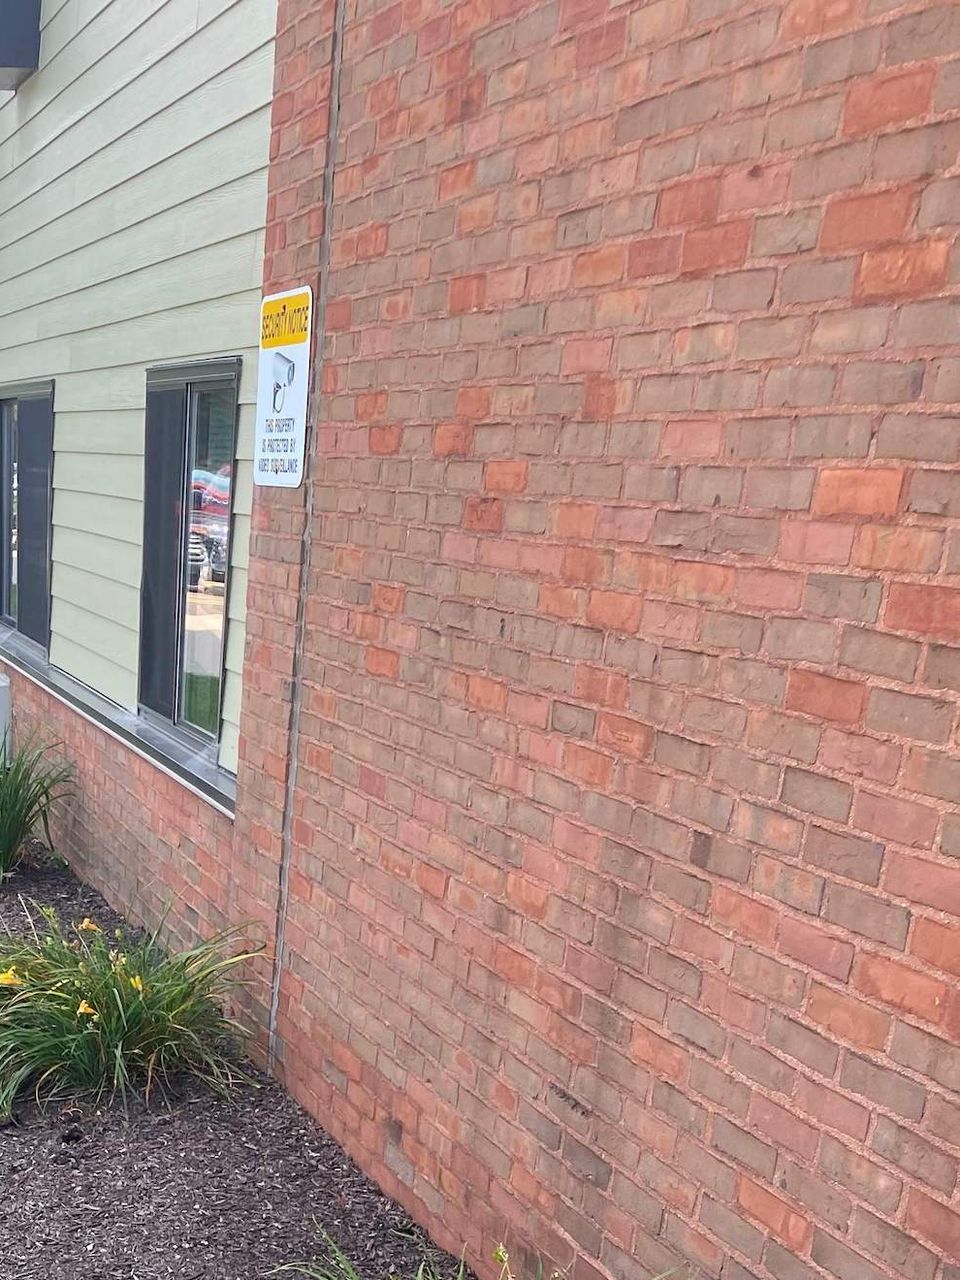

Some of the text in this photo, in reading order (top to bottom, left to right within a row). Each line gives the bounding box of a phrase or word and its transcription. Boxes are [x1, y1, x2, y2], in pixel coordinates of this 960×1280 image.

[262, 305, 308, 339] SECURITY NOTICE
[265, 417, 295, 433] THIS PROPERTY
[267, 438, 288, 453] PROTECTED
[290, 438, 296, 453] BY
